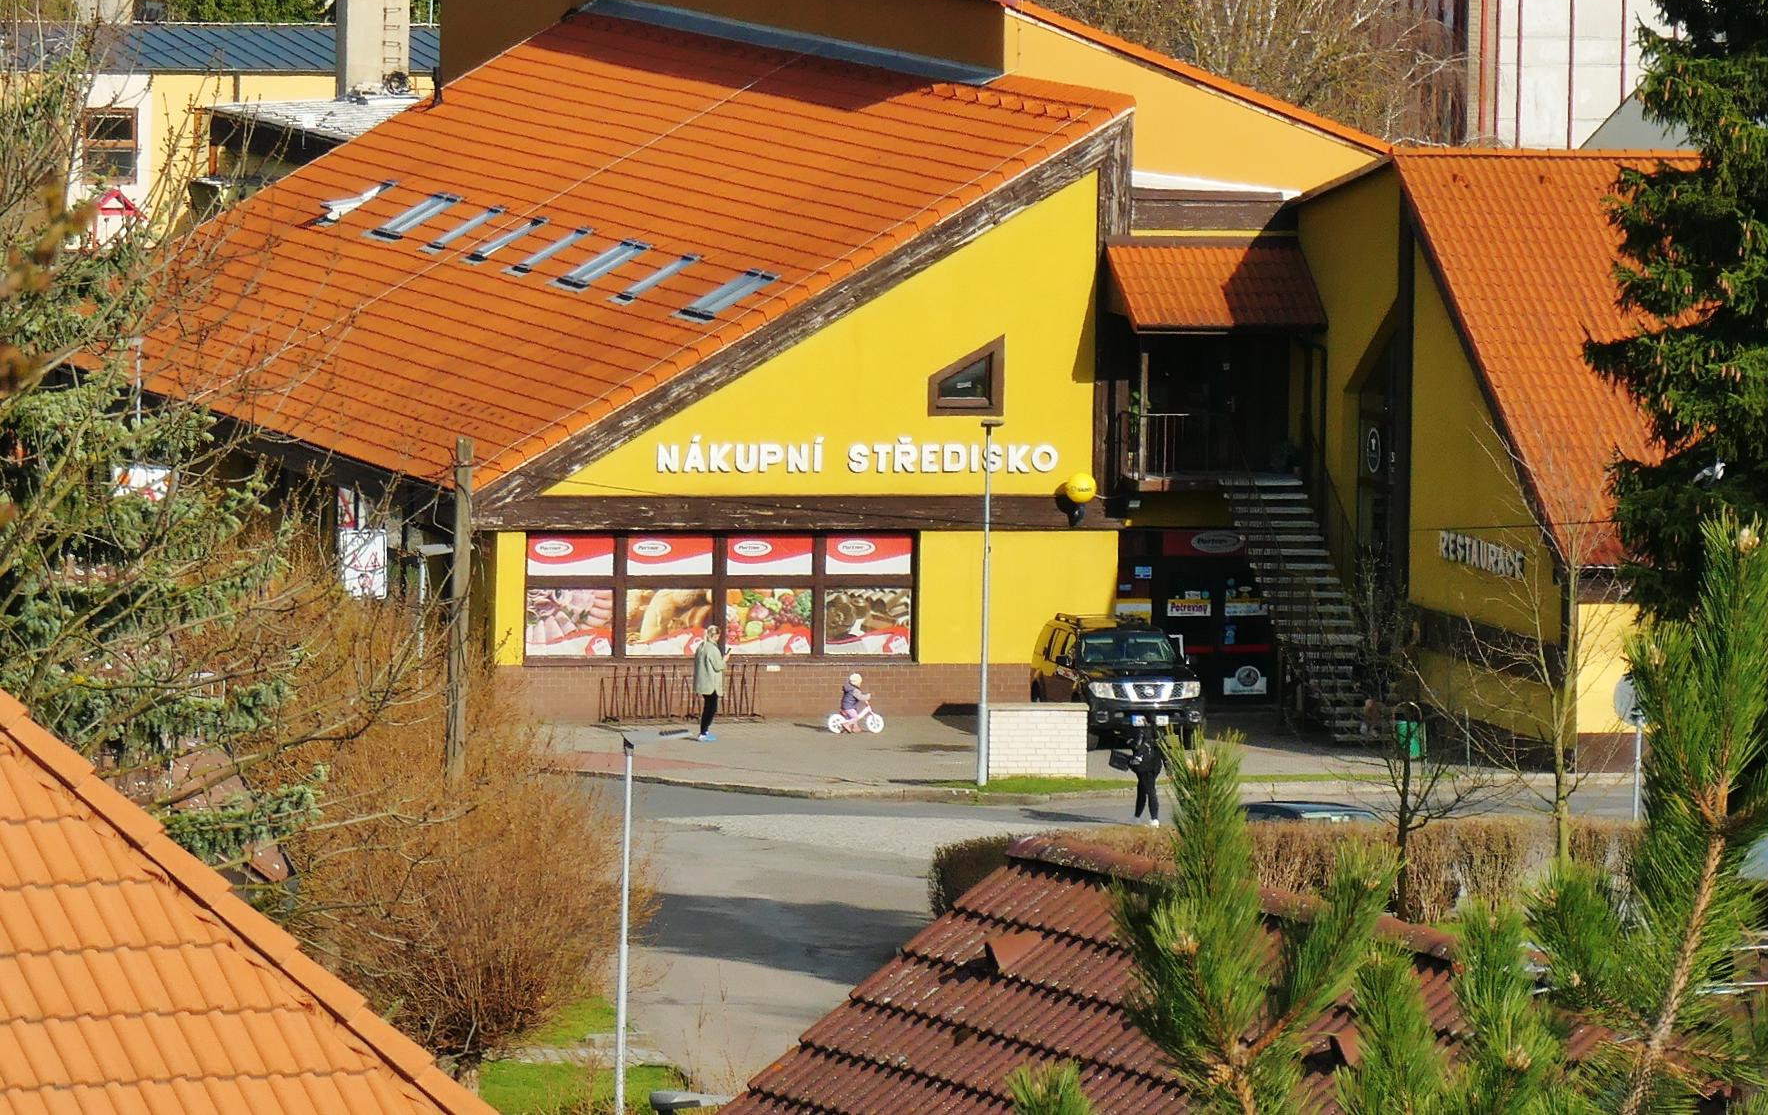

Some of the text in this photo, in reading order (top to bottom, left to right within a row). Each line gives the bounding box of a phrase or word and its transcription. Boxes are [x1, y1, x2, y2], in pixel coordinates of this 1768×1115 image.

[656, 434, 1059, 474] NÁKUPNÍ STŘEDISKO
[1439, 530, 1526, 582] RESTAURACE
